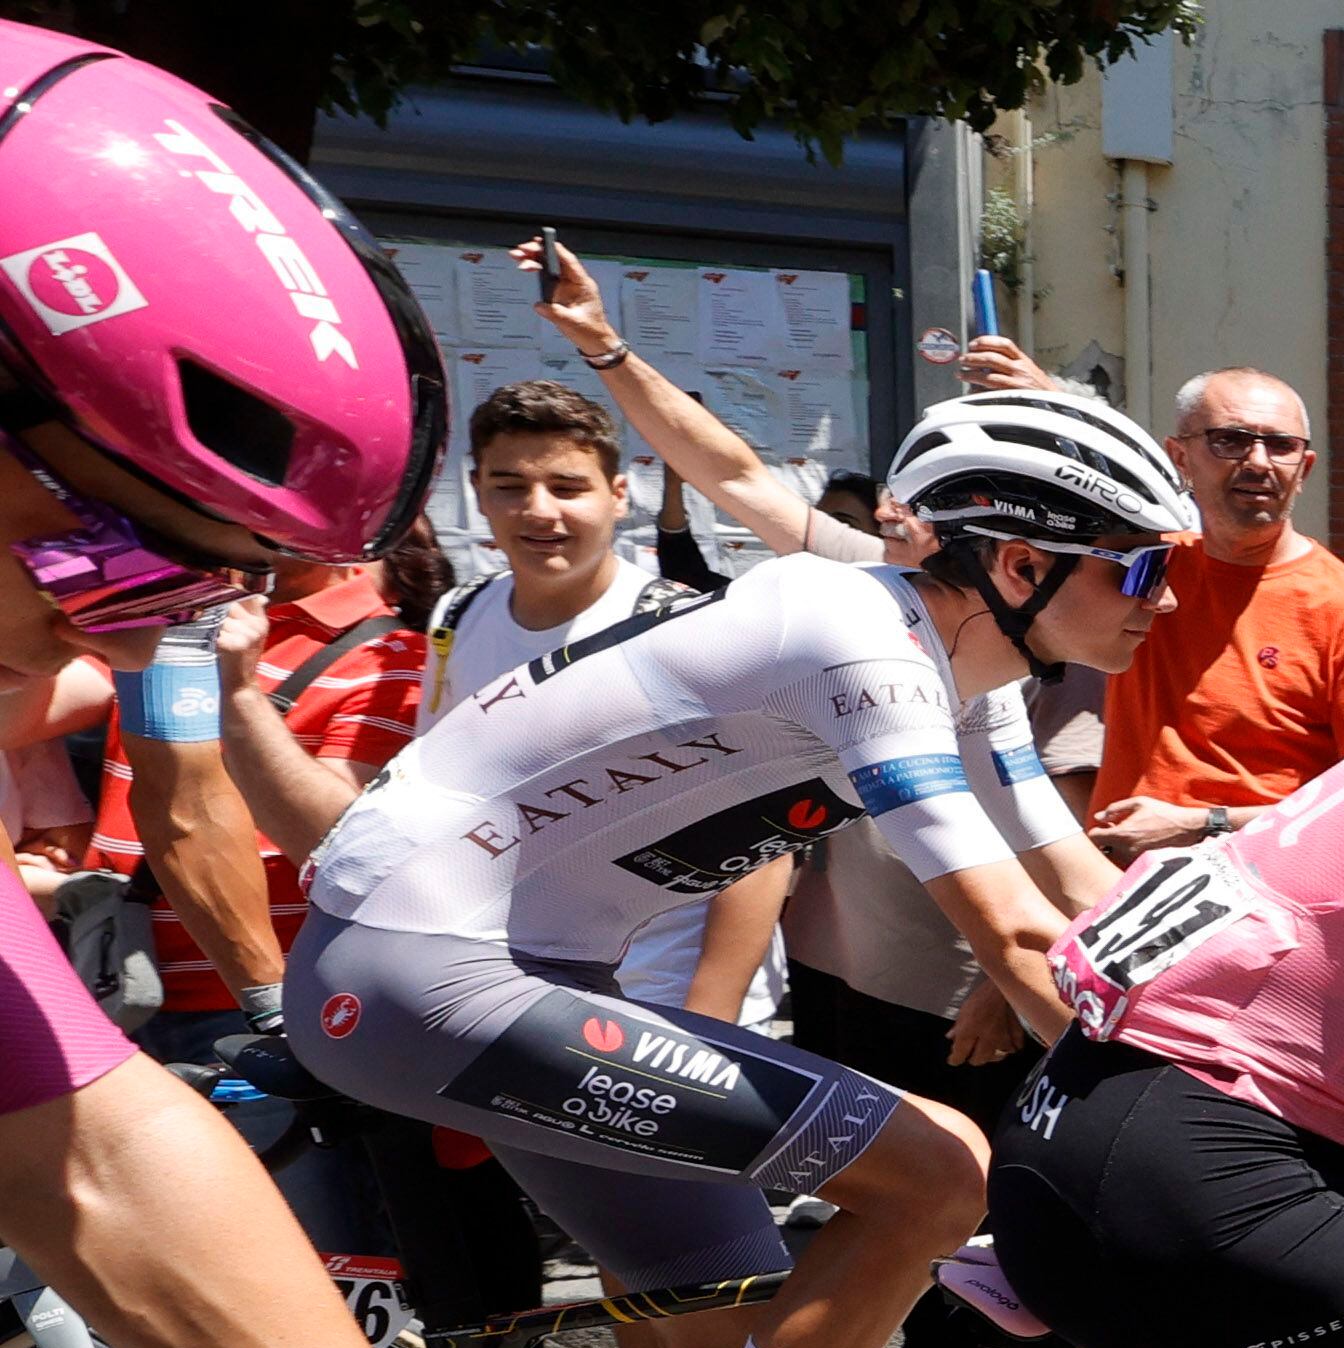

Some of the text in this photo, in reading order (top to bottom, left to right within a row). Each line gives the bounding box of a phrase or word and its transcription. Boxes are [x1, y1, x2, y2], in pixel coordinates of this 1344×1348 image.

[152, 118, 360, 370] TREK
[993, 498, 1037, 521] VISMA
[1046, 510, 1077, 524] lease
[898, 756, 941, 771] CUCINA
[459, 732, 745, 861] EATALY
[632, 1030, 743, 1092] VISMA
[577, 1065, 678, 1116] lease
[773, 1084, 880, 1195] EATALY
[32, 1306, 65, 1323] POLTI
